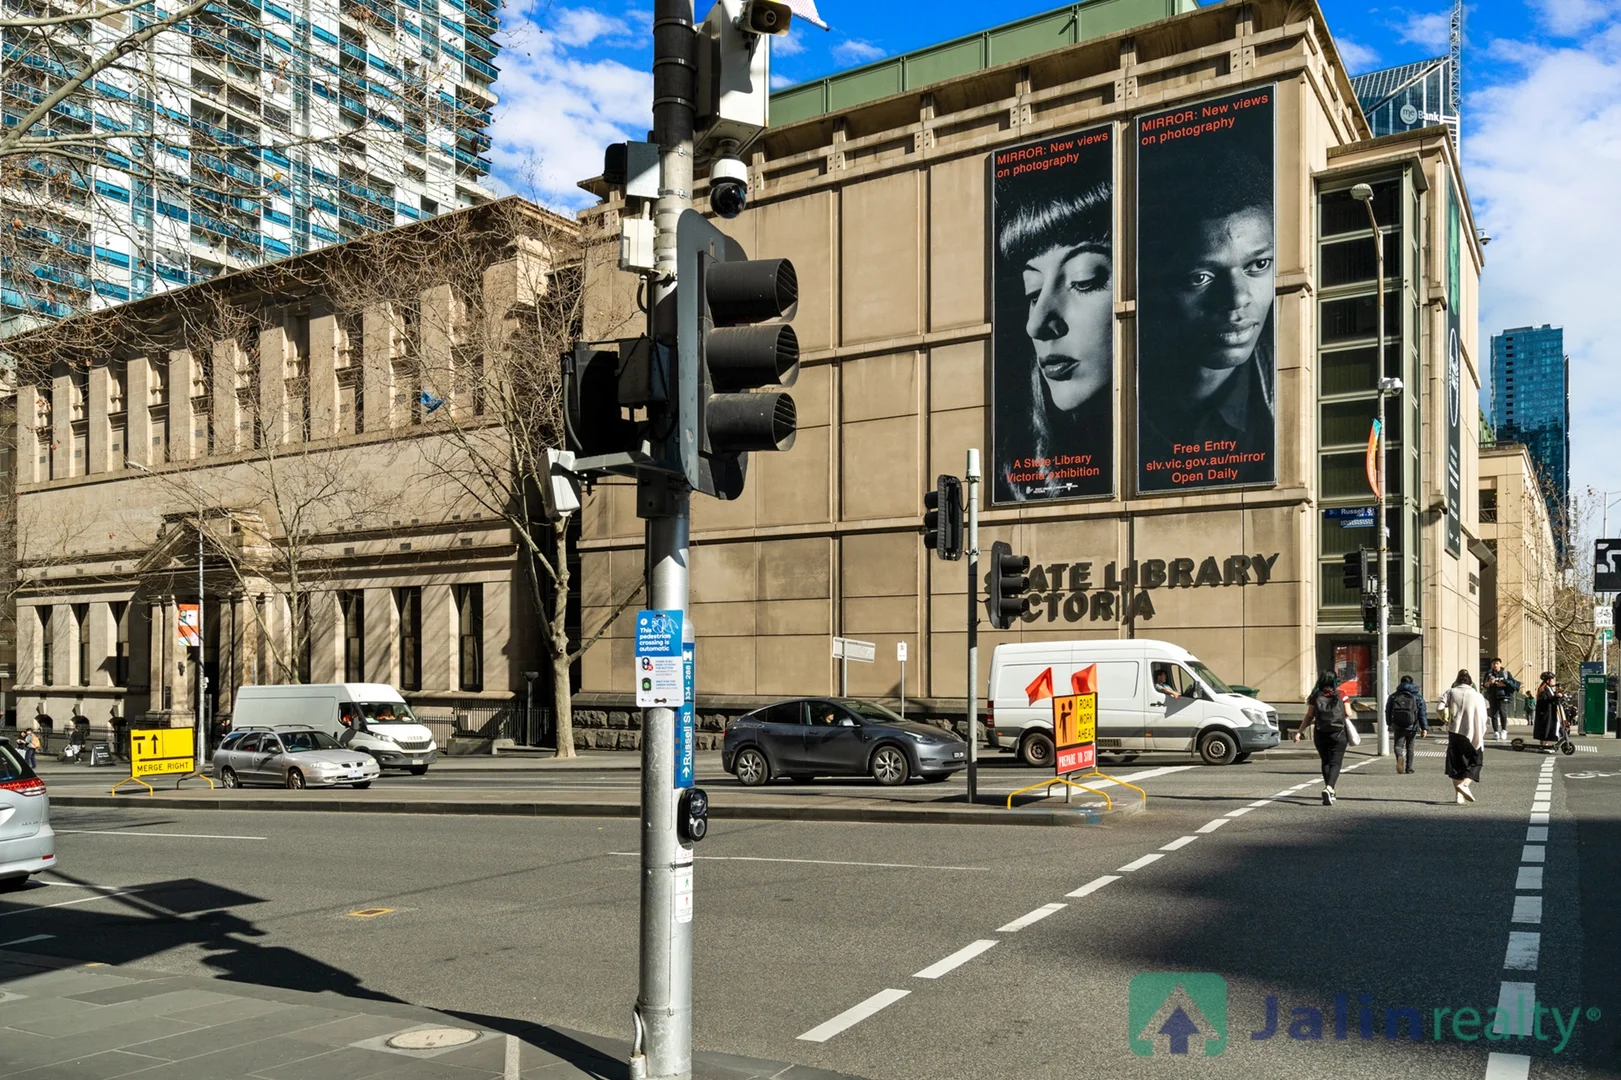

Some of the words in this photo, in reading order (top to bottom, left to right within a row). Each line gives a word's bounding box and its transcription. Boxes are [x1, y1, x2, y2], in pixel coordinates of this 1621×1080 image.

[1141, 111, 1197, 131] MIRROR:
[1203, 105, 1229, 117] New
[1233, 95, 1268, 110] views
[1418, 110, 1439, 121] Bank
[1141, 136, 1156, 145] on
[1160, 117, 1235, 143] photography
[997, 146, 1046, 165] MIRROR:
[1050, 141, 1073, 152] New
[1077, 132, 1109, 146] views
[997, 169, 1010, 178] on
[1013, 153, 1080, 175] photography
[1173, 443, 1201, 454] Free
[1205, 441, 1236, 453] Entry
[1013, 459, 1021, 468] A
[1024, 457, 1051, 469] State
[1055, 455, 1092, 467] Library
[1146, 451, 1266, 471] slv.vic.gov.au/mirror
[1006, 471, 1045, 483] Victoria
[1048, 466, 1100, 480] exhibition
[1172, 470, 1203, 484] Open
[1208, 469, 1238, 482] Daily
[1341, 507, 1365, 515] Russell
[1104, 552, 1280, 592] LIBRARY
[1079, 698, 1093, 710] ROAD
[683, 711, 691, 723] St
[1079, 713, 1093, 724] WORK
[1078, 727, 1094, 739] AHEAD
[683, 726, 691, 766] Russell
[1058, 753, 1076, 767] PREPARE
[1077, 752, 1083, 763] TO
[1084, 750, 1093, 762] STOP
[137, 763, 163, 773] MERGE
[167, 762, 189, 770] RIGHT
